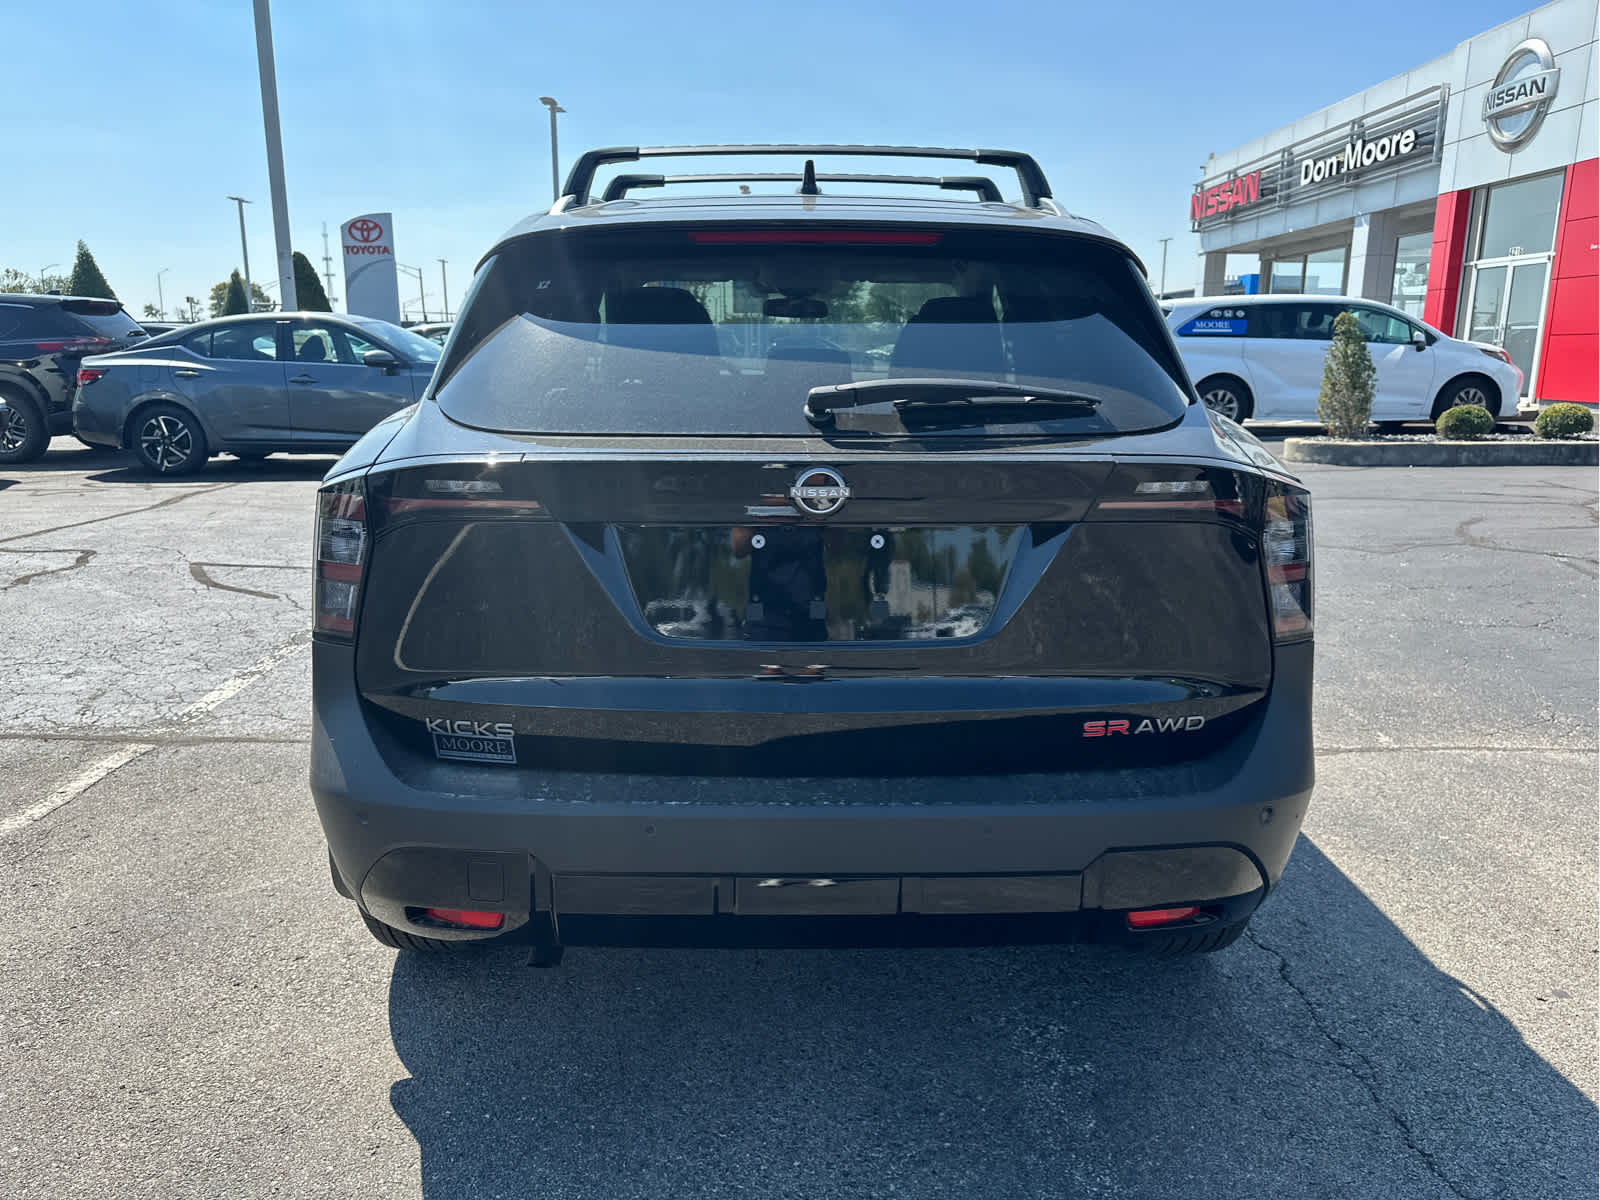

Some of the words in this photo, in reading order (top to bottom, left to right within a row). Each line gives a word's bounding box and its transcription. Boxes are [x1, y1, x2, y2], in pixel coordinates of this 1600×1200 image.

[1486, 77, 1547, 110] NISSAN
[1300, 156, 1338, 186] Don
[1341, 129, 1416, 173] Moore
[1190, 170, 1261, 221] NISSAN
[343, 245, 392, 255] TOYOTA
[1195, 320, 1231, 329] MOORE
[792, 488, 849, 497] NISSAN
[425, 717, 515, 738] KICKS
[1082, 720, 1130, 737] SR
[1134, 715, 1206, 734] AWD
[440, 737, 508, 754] MOORE
